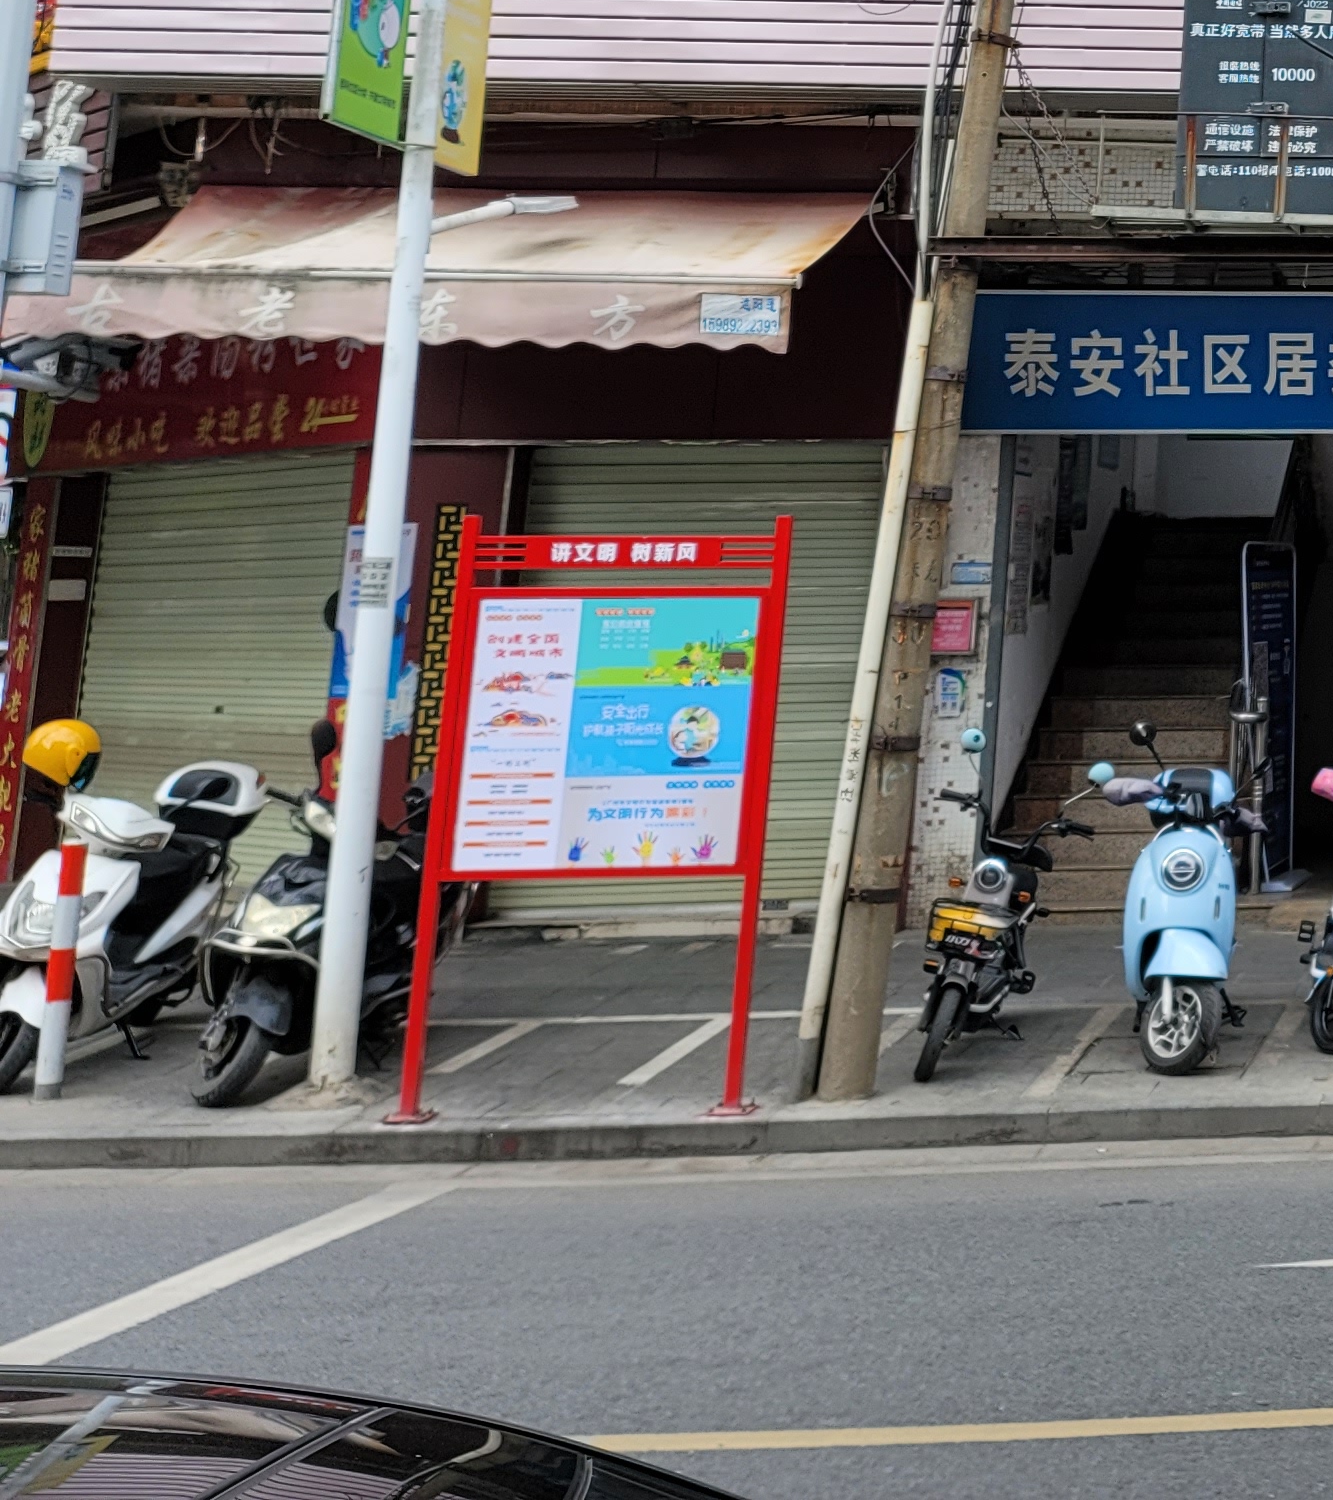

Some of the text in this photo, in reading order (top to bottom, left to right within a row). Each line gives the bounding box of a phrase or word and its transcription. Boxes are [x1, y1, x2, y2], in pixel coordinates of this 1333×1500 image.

[1190, 23, 1265, 38] 真正好宽带
[1271, 69, 1316, 82] 10000
[1205, 124, 1255, 136] 通信设施
[1203, 139, 1254, 152] 严禁破坏
[551, 542, 698, 563] 讲文明 树新风
